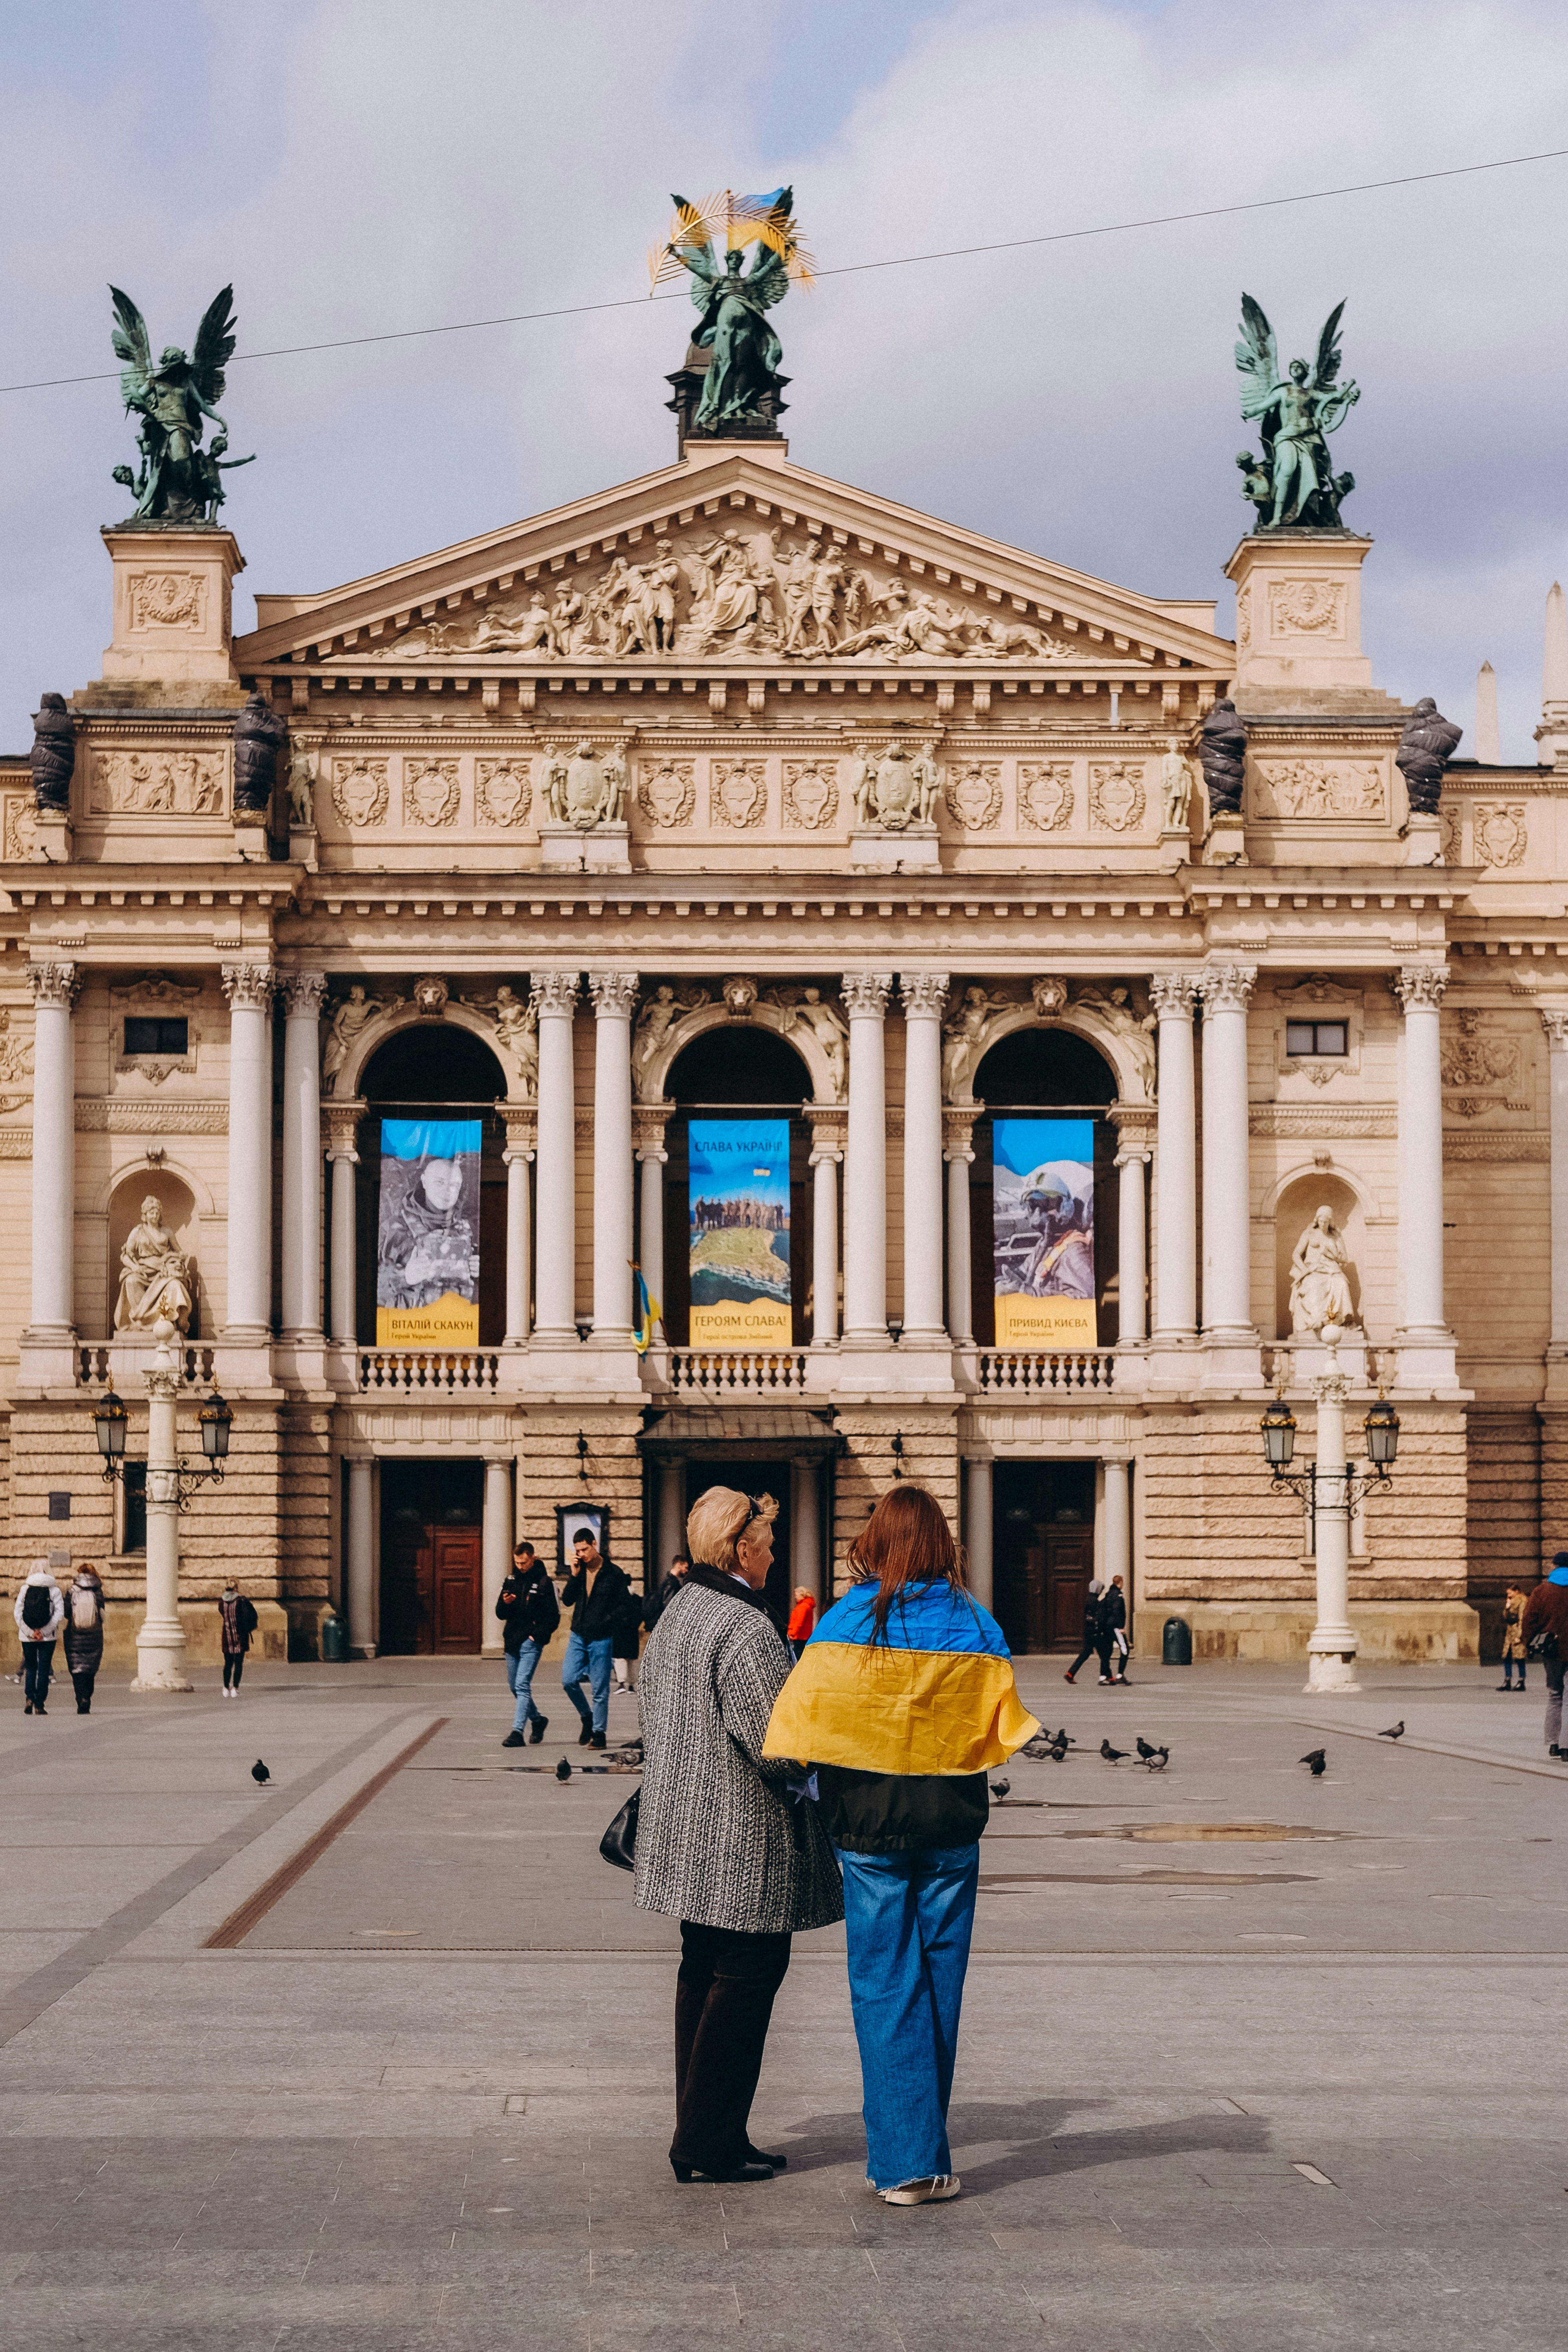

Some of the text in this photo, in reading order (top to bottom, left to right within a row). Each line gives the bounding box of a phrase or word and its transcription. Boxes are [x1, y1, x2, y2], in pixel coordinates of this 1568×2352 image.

[695, 1141, 732, 1152] СЛАВА
[392, 1319, 473, 1330] ВІТАЛІЙ СКАКУН
[695, 1316, 786, 1326] ГЕРОЯМ СЛАВА!
[1010, 1318, 1088, 1328] ПРИВИД КИЄВА
